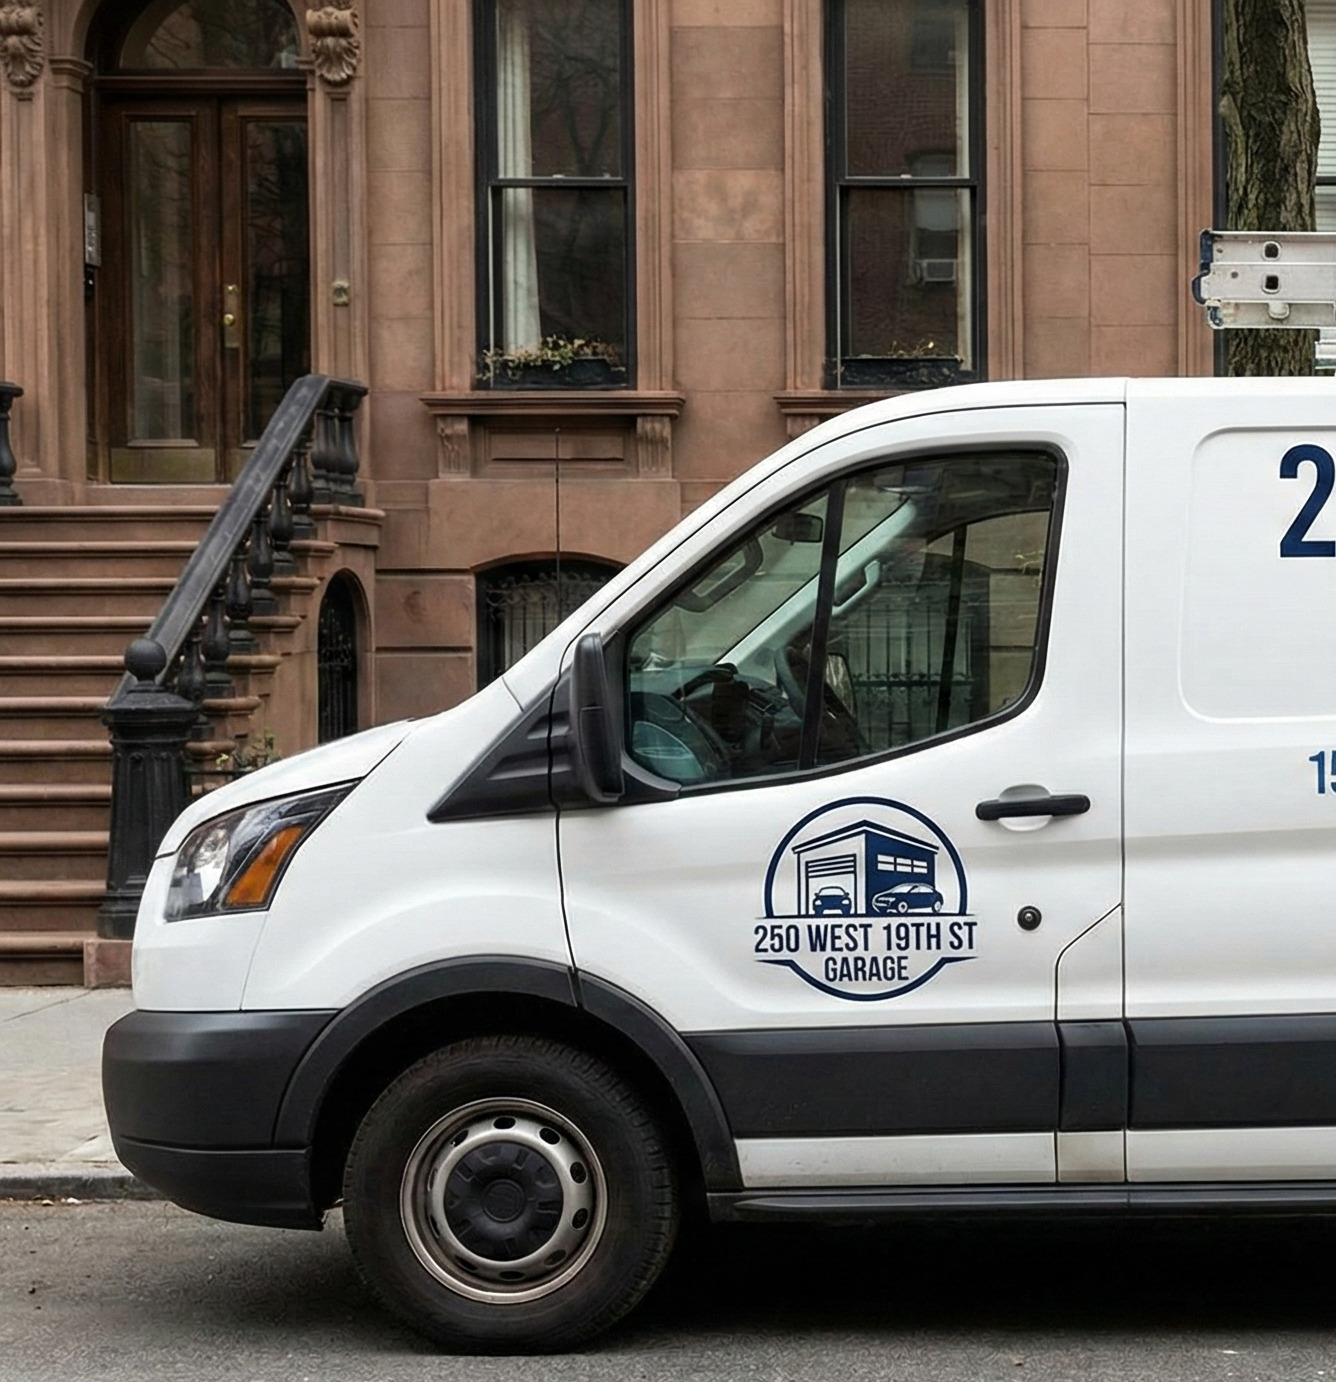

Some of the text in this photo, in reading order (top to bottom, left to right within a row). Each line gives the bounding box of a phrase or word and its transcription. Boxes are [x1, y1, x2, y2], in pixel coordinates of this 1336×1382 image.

[753, 921, 978, 953] 250 WEST 19TH ST
[824, 956, 910, 983] GARAGE
